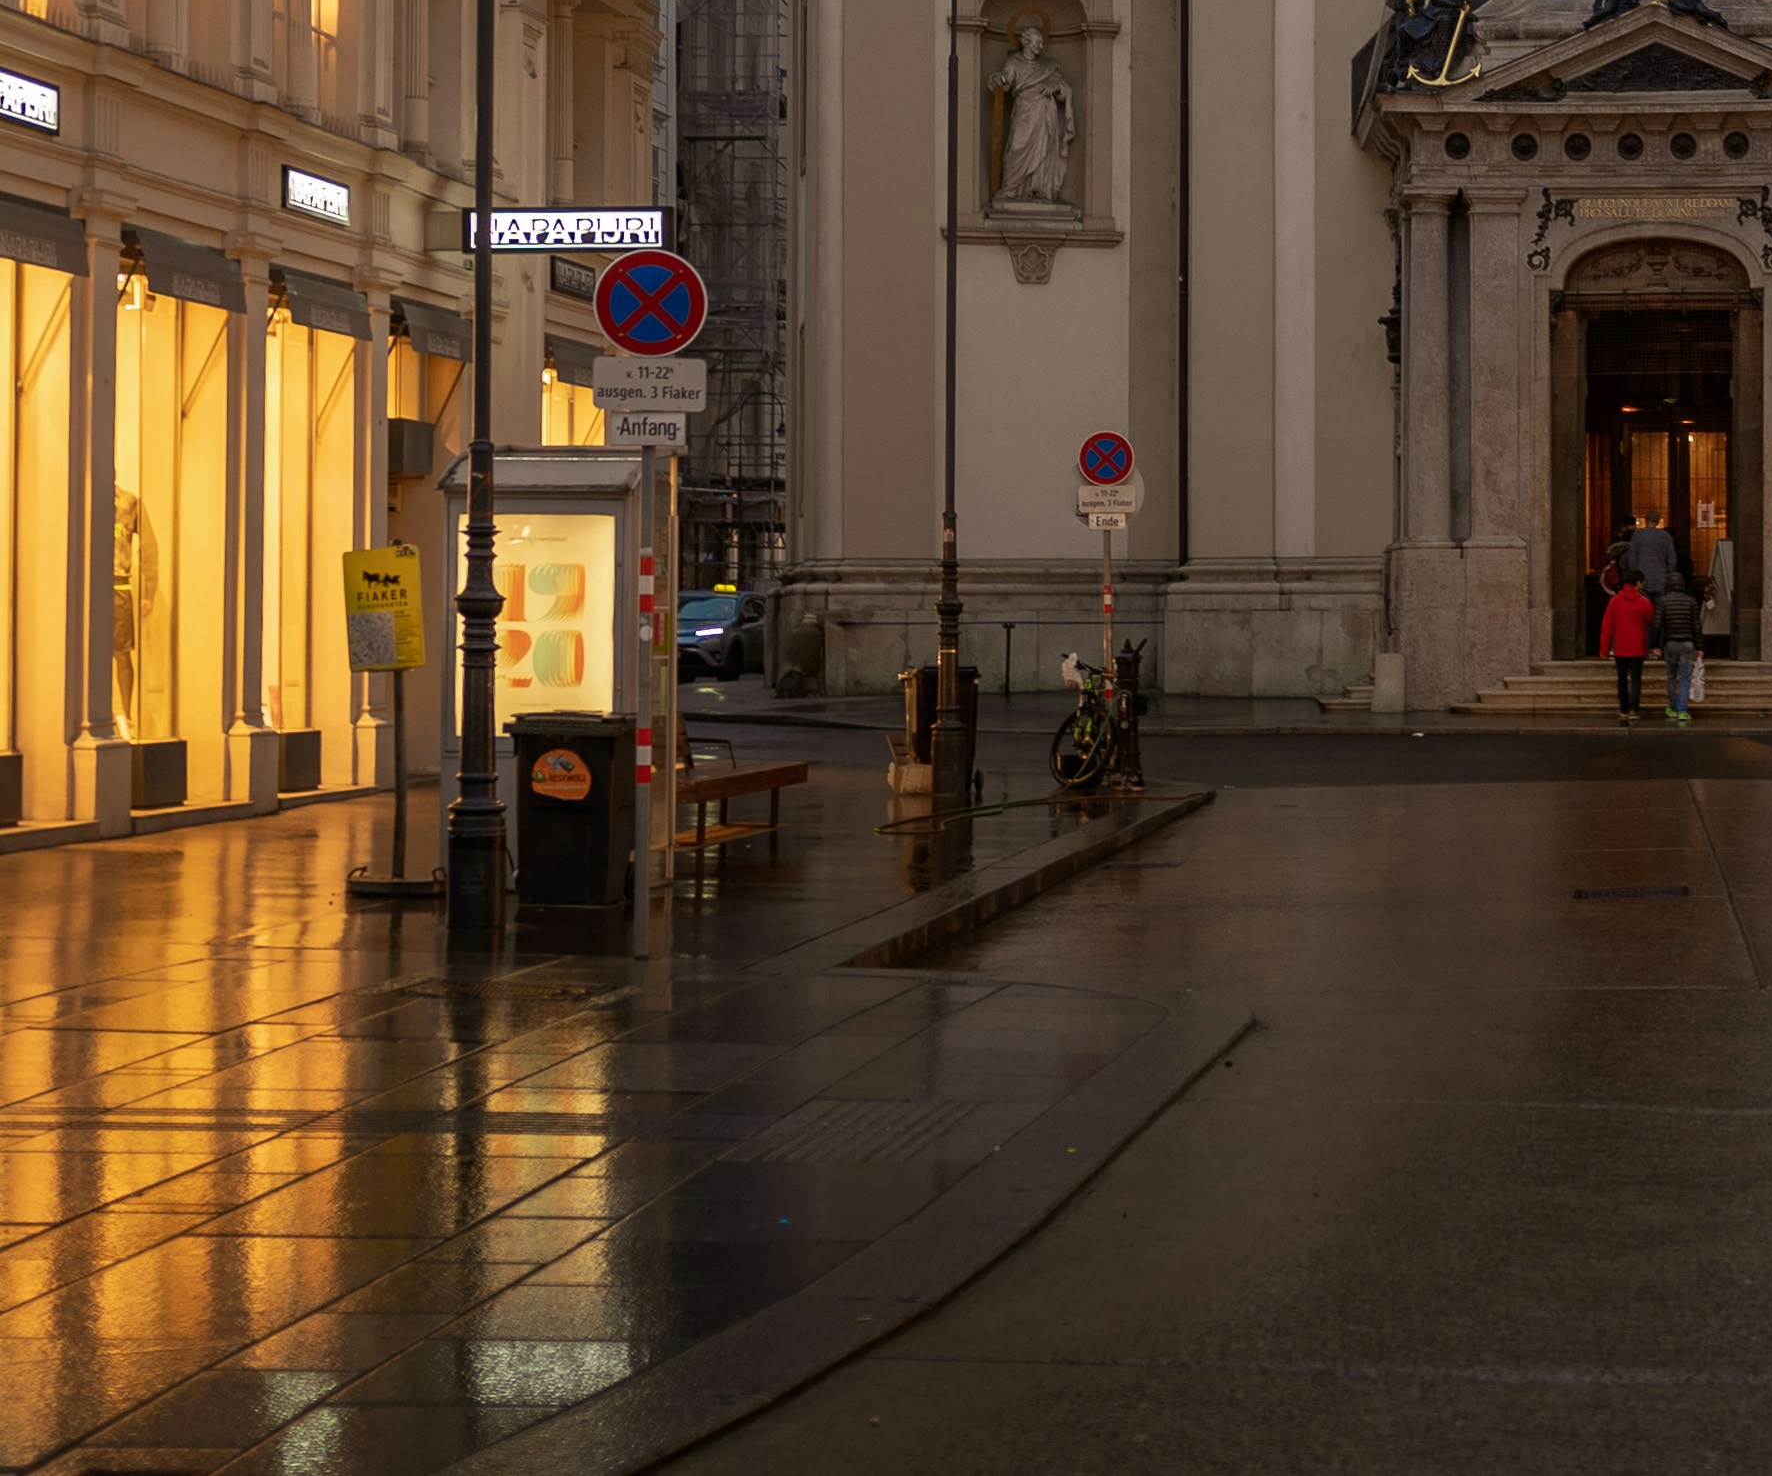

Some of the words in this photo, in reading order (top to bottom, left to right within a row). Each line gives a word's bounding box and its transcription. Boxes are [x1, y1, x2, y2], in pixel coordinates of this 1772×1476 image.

[597, 387, 647, 401] ausgen.
[650, 386, 659, 399] 3
[662, 387, 701, 400] Fiaker
[620, 417, 678, 441] Anfang
[1096, 515, 1119, 527] Ende
[357, 588, 408, 603] FIAKER
